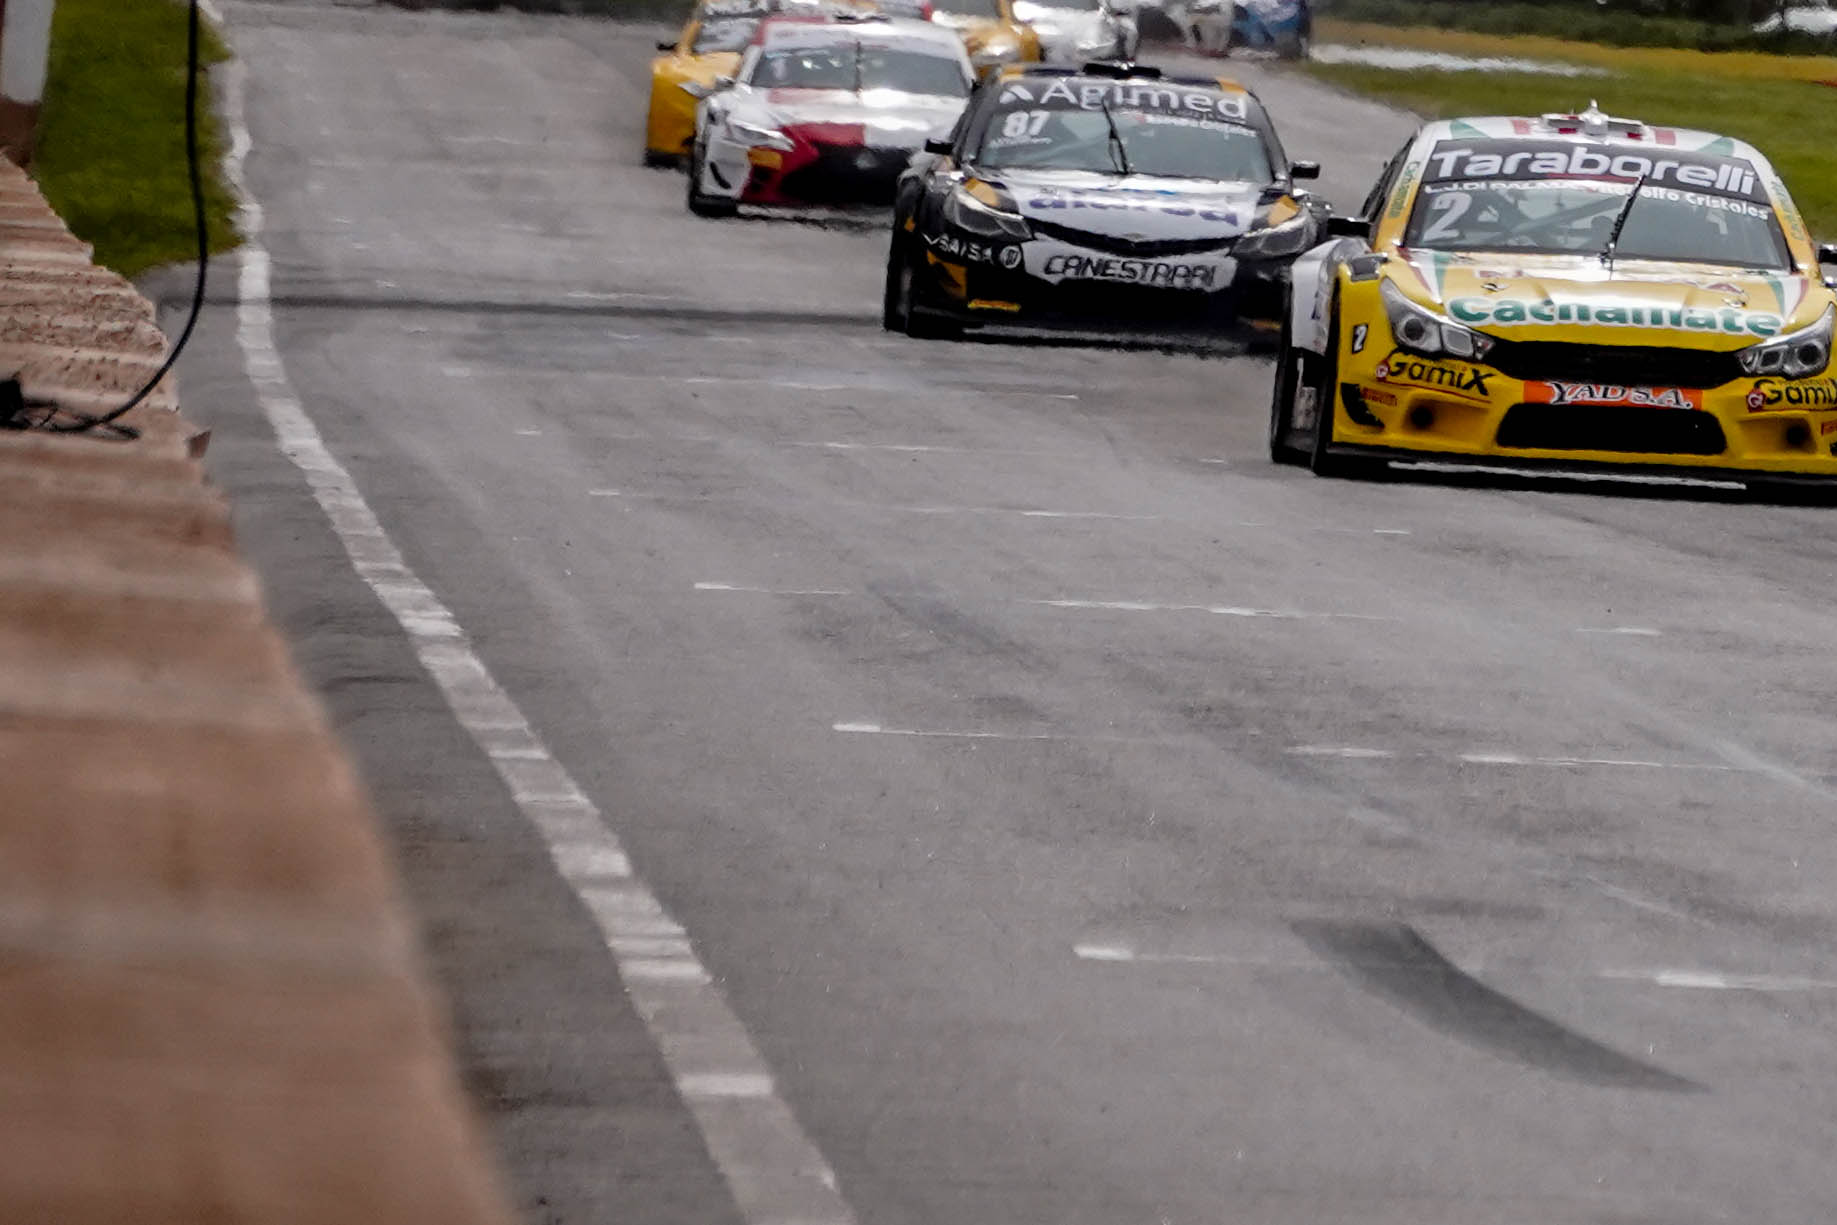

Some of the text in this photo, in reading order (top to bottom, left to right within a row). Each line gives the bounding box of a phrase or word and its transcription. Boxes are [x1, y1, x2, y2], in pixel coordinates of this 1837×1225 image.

[1431, 147, 1756, 195] Taraborelli
[1422, 190, 1473, 242] 2
[1685, 192, 1768, 220] Cristales
[1543, 371, 1628, 396] YAD
